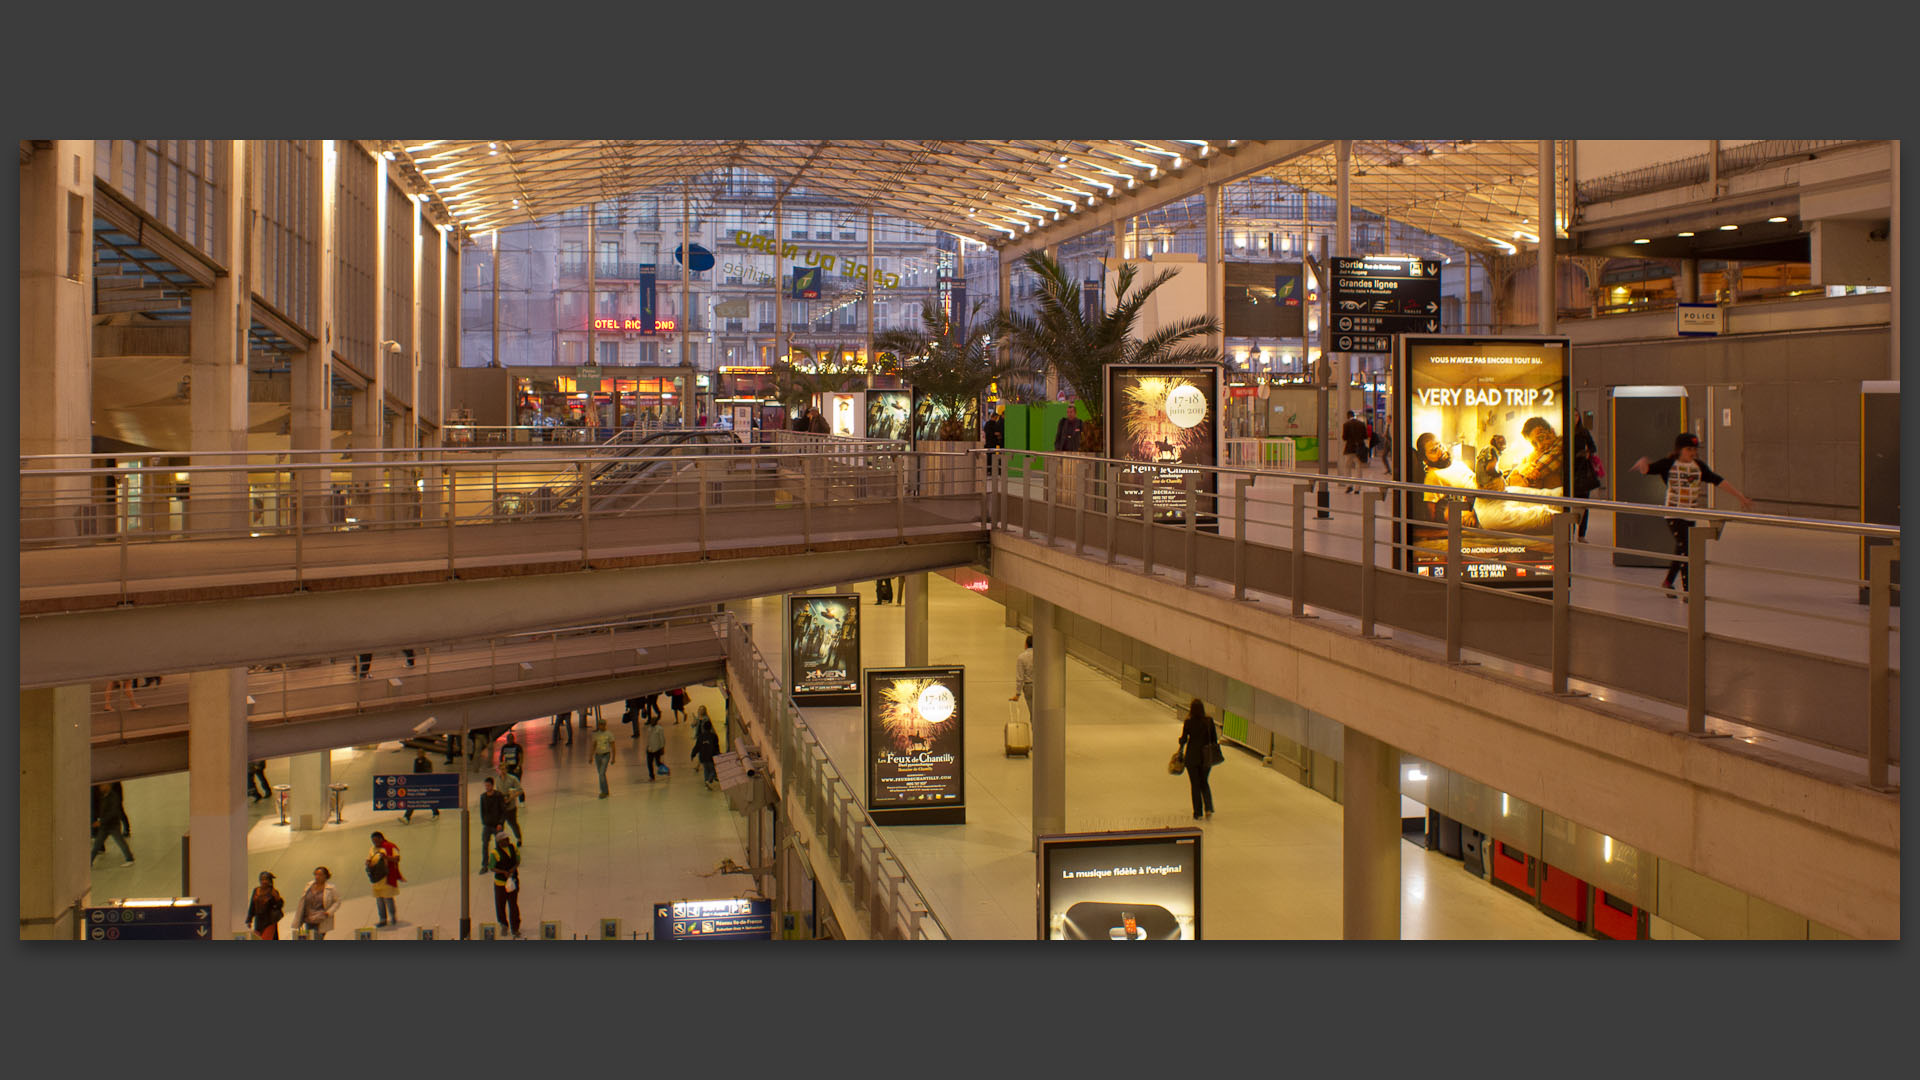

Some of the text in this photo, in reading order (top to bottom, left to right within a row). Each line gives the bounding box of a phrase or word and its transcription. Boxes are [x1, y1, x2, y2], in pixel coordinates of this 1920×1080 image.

[1339, 260, 1363, 269] Sortie
[1339, 278, 1399, 290] Grandes lignes
[594, 319, 675, 330] OTEL RICOND
[1430, 356, 1449, 364] VOUS
[1449, 356, 1473, 364] N'AVEZ
[1487, 357, 1513, 365] ENCORE
[1513, 357, 1531, 365] TOUT
[1174, 394, 1199, 408] 17-18
[1417, 388, 1554, 406] VERY BAD TRIP 2
[1169, 407, 1204, 417] juin 2011
[1499, 546, 1525, 554] BANGKOK
[1467, 564, 1508, 572] AU CINEMA
[887, 753, 911, 764] Feux
[919, 752, 955, 765] Chantilly
[1063, 865, 1182, 879] La musique fidèle à l'original
